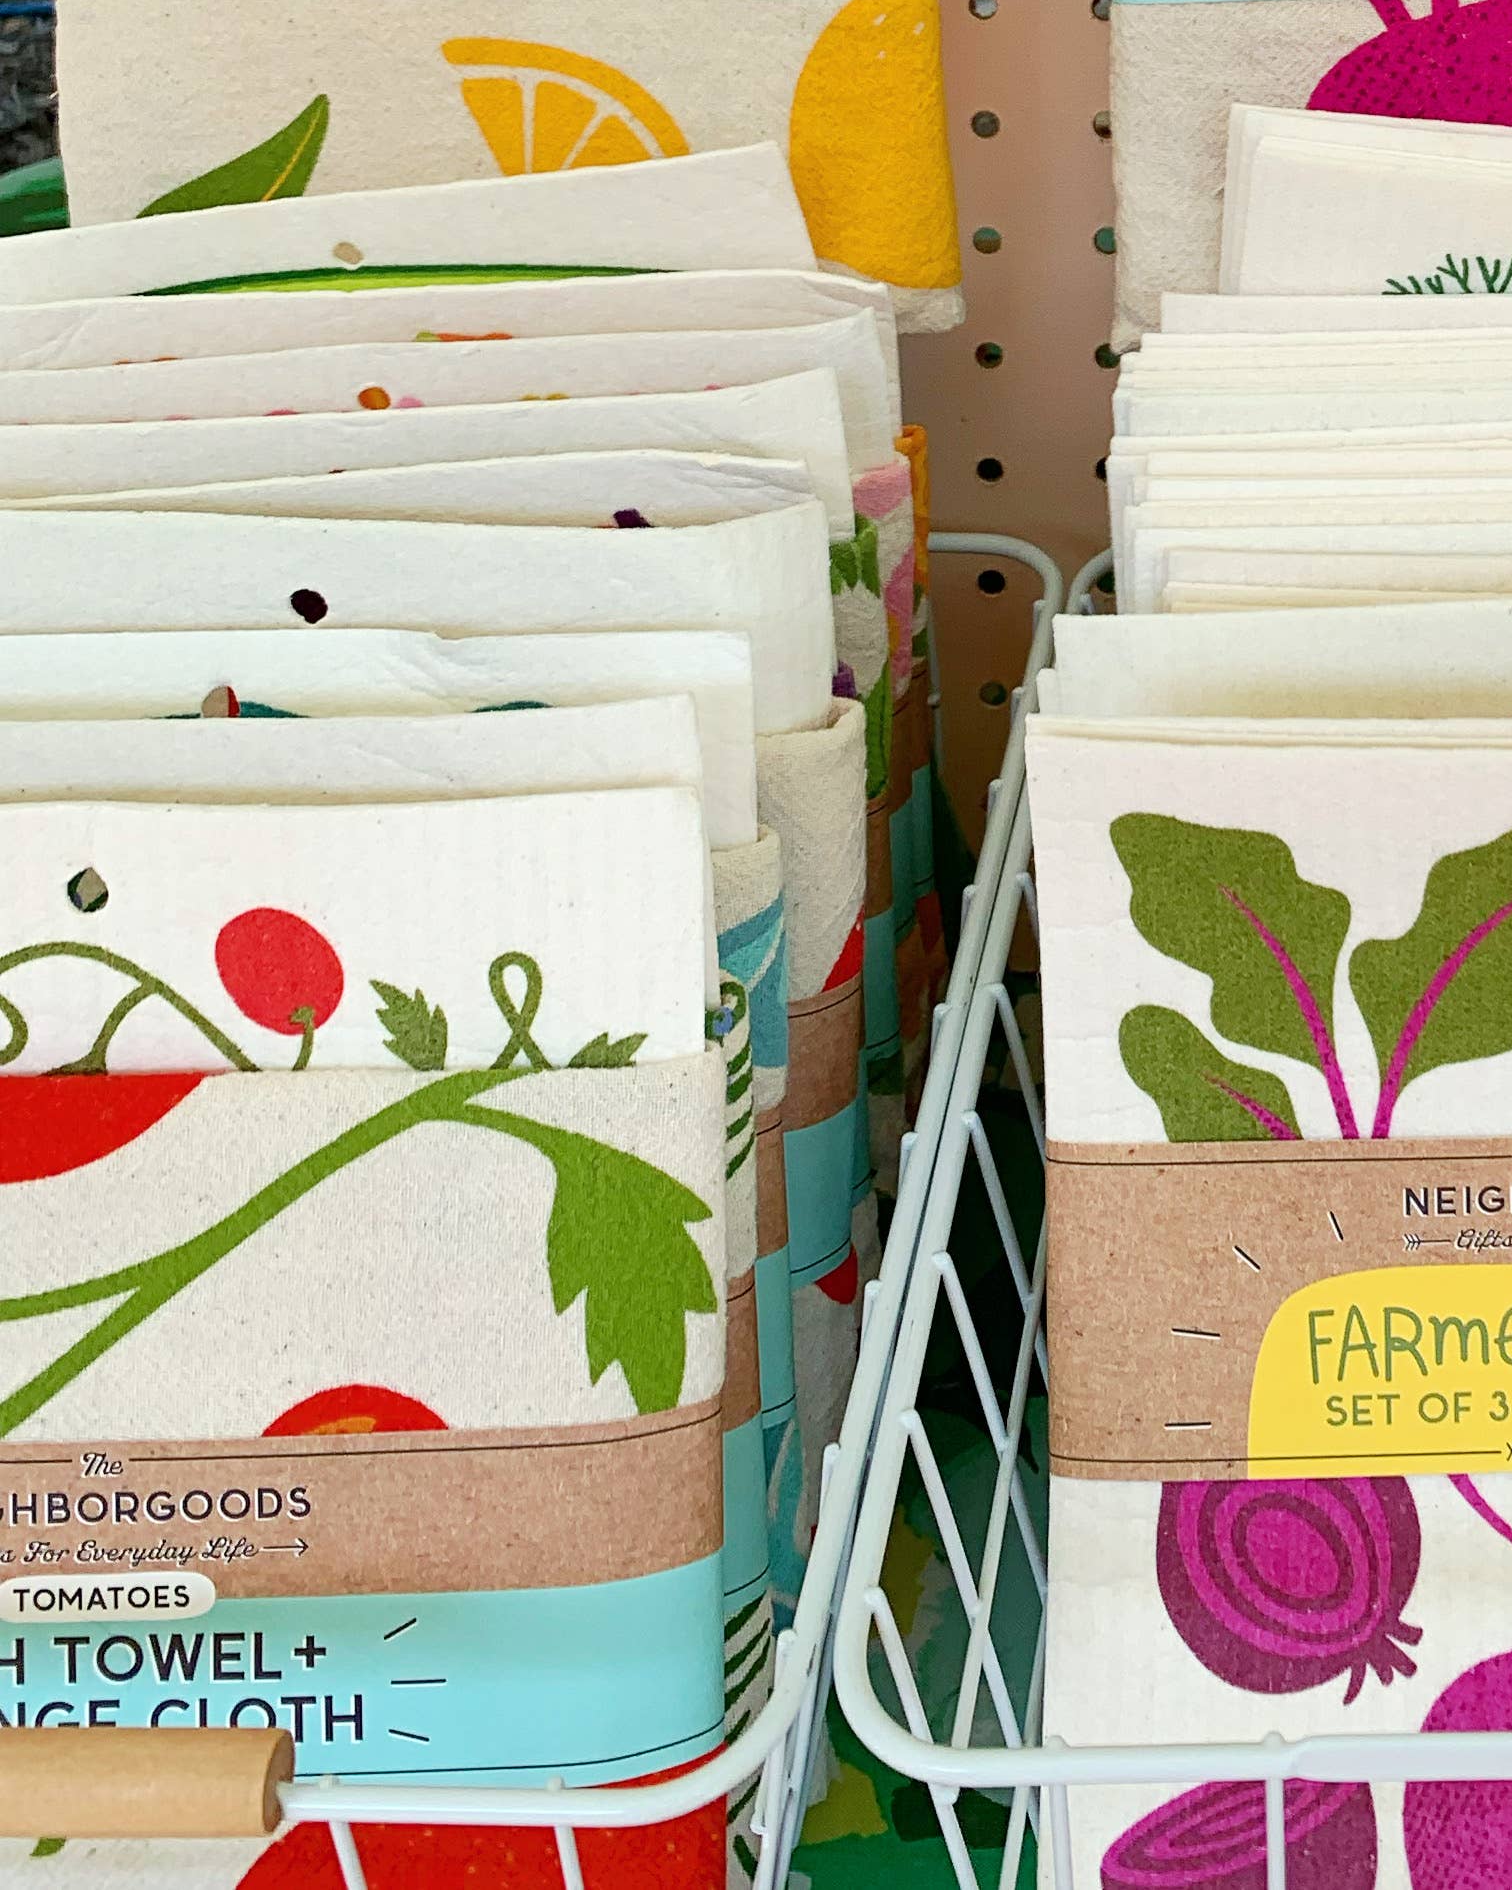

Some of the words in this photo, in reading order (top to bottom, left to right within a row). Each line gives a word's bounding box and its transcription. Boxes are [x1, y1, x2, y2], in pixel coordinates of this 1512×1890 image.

[1326, 1393, 1401, 1426] SET
[1418, 1391, 1472, 1423] OF
[1489, 1390, 1510, 1421] 3
[83, 1452, 124, 1475] The
[0, 1487, 311, 1524] HBORGOODS
[23, 1541, 70, 1562] For
[76, 1538, 198, 1566] Everyday
[201, 1536, 259, 1563] Life
[12, 1585, 190, 1612] TOMATOES
